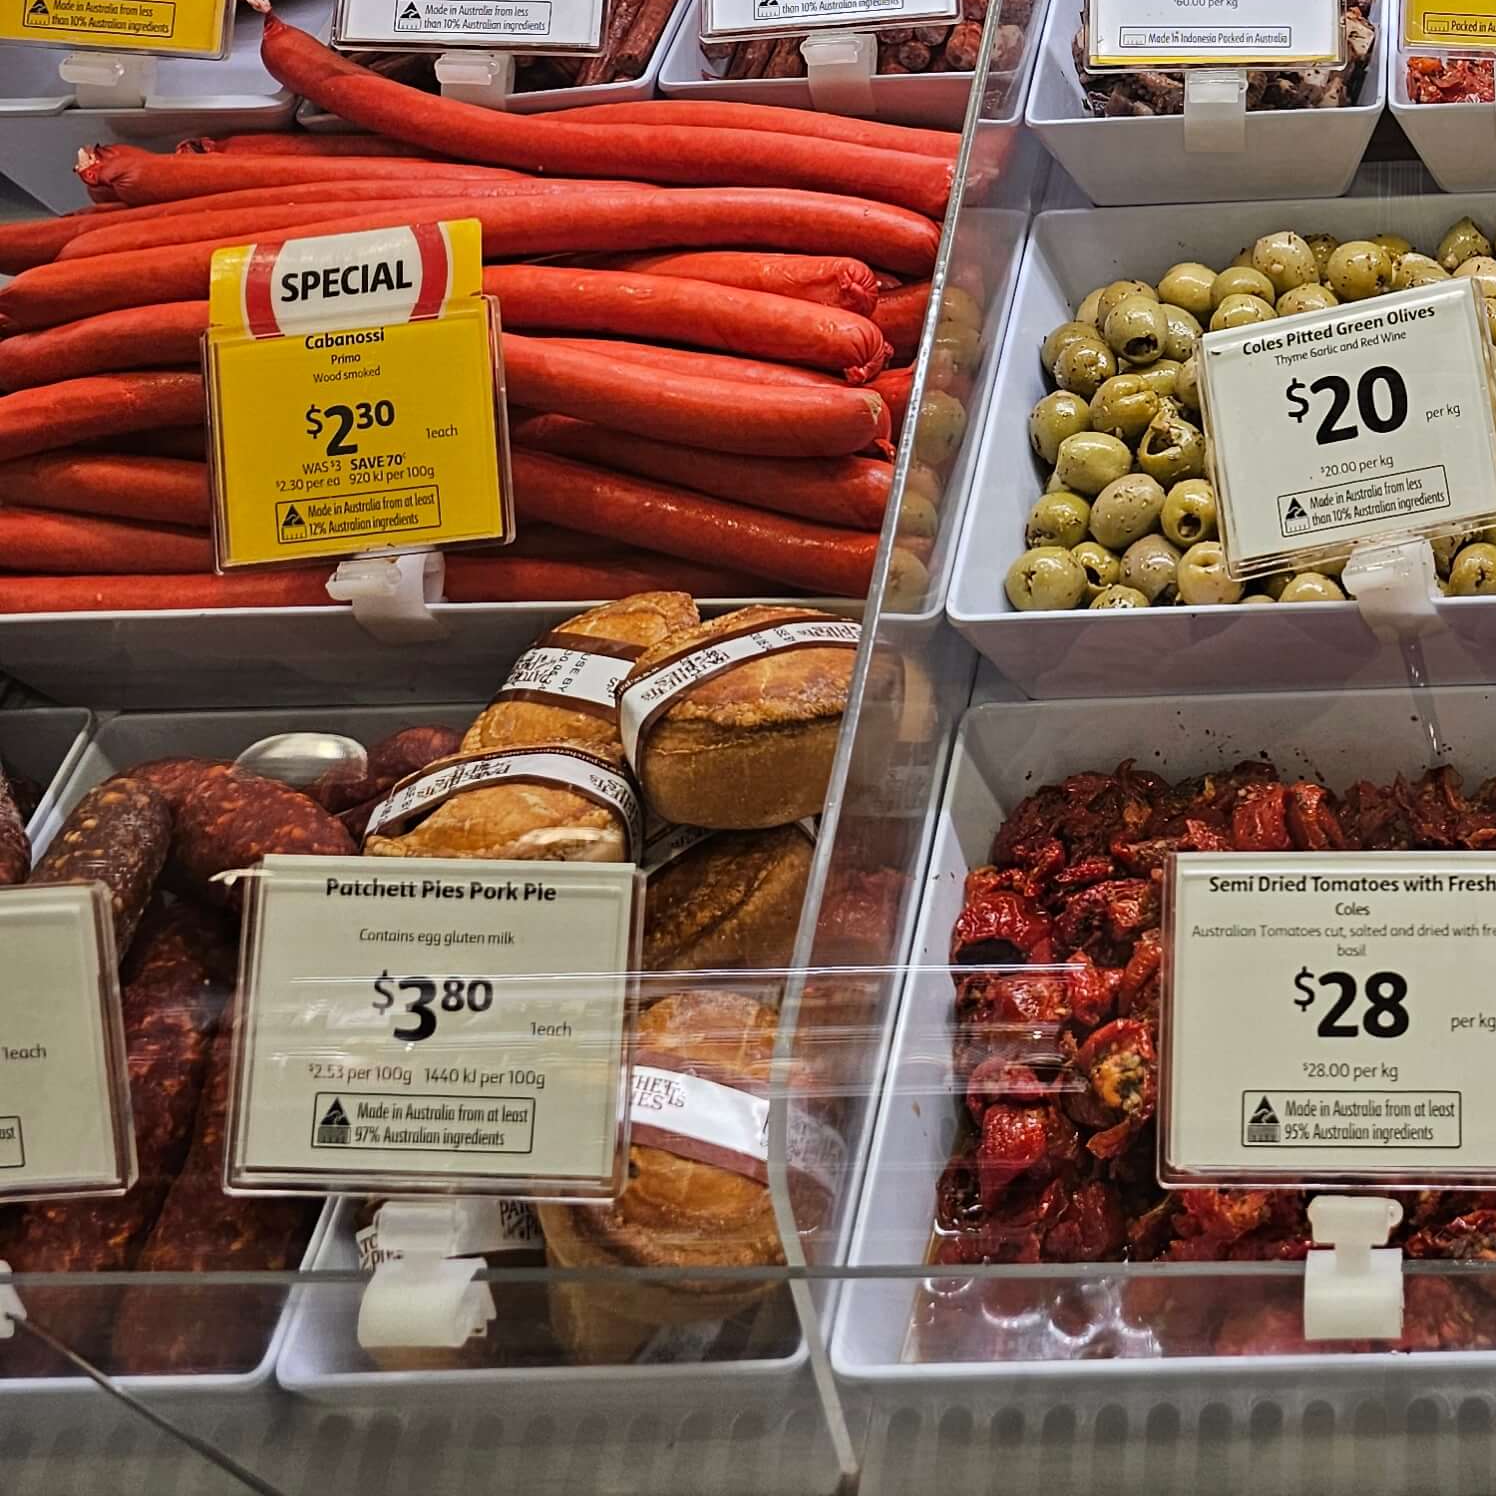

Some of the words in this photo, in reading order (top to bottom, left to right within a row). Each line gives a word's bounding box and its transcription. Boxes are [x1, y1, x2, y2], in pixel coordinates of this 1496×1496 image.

[280, 260, 413, 303] SPECIAL
[305, 327, 385, 350] Cabanossi
[1243, 337, 1283, 355] Coles
[1286, 324, 1333, 347] Pitted
[1337, 314, 1384, 336] Green
[1387, 304, 1435, 326] Olives
[1274, 351, 1308, 366] Thyme
[1310, 343, 1338, 358] Garlic
[1340, 339, 1358, 353] and
[1360, 336, 1380, 348] Red
[1381, 329, 1407, 344] Wine
[331, 352, 361, 365] Primo
[1286, 365, 1408, 446] $20
[1425, 407, 1445, 421] per
[1446, 403, 1461, 418] kg
[426, 424, 458, 440] 1each
[326, 878, 418, 898] Patchett
[421, 881, 465, 899] Pies
[470, 882, 518, 901] Pork
[523, 883, 557, 901] Pie
[1209, 876, 1254, 893] Semi
[1258, 876, 1307, 893] Dried
[1313, 876, 1400, 893] Tomatoes
[1404, 875, 1445, 893] with
[1448, 875, 1496, 893] Fresh
[1335, 902, 1371, 916] Coles
[359, 928, 415, 944] Contains
[417, 932, 441, 946] egg
[444, 930, 485, 946] gluten
[487, 931, 515, 945] milk
[1293, 966, 1409, 1039] $28
[530, 1021, 572, 1037] 1each
[1450, 1014, 1475, 1031] per
[1478, 1013, 1496, 1032] kg
